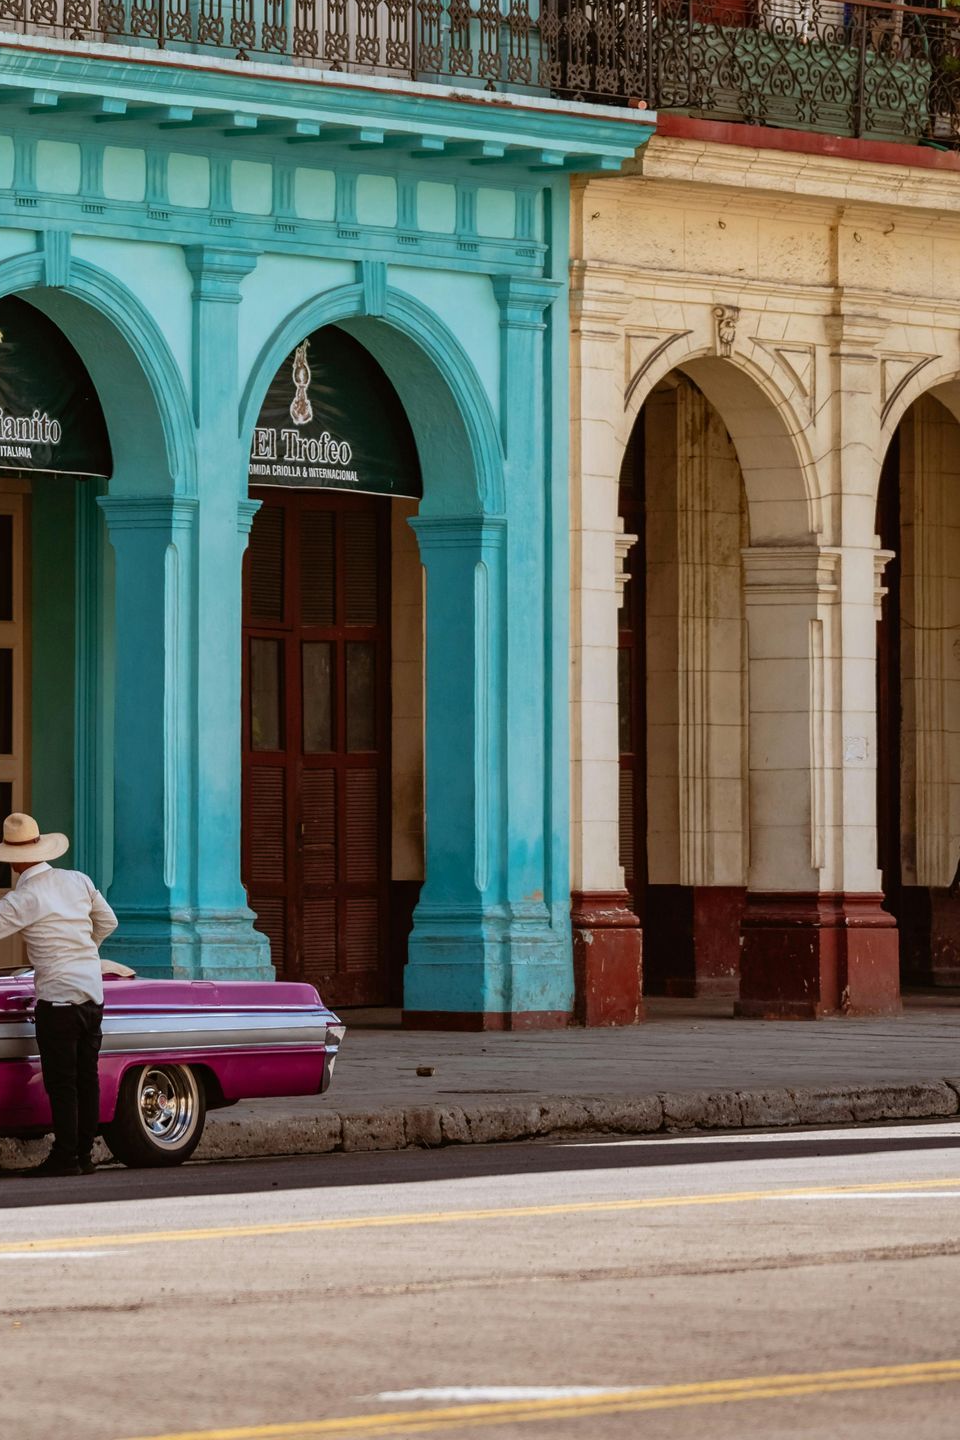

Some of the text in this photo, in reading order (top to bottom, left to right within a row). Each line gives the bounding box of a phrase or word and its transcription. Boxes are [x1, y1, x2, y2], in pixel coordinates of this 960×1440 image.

[0, 446, 32, 459] ITALIANA
[252, 428, 352, 465] El Trofeo
[249, 464, 359, 482] OMIDA CRIOLLA & INTERNACIONAL
